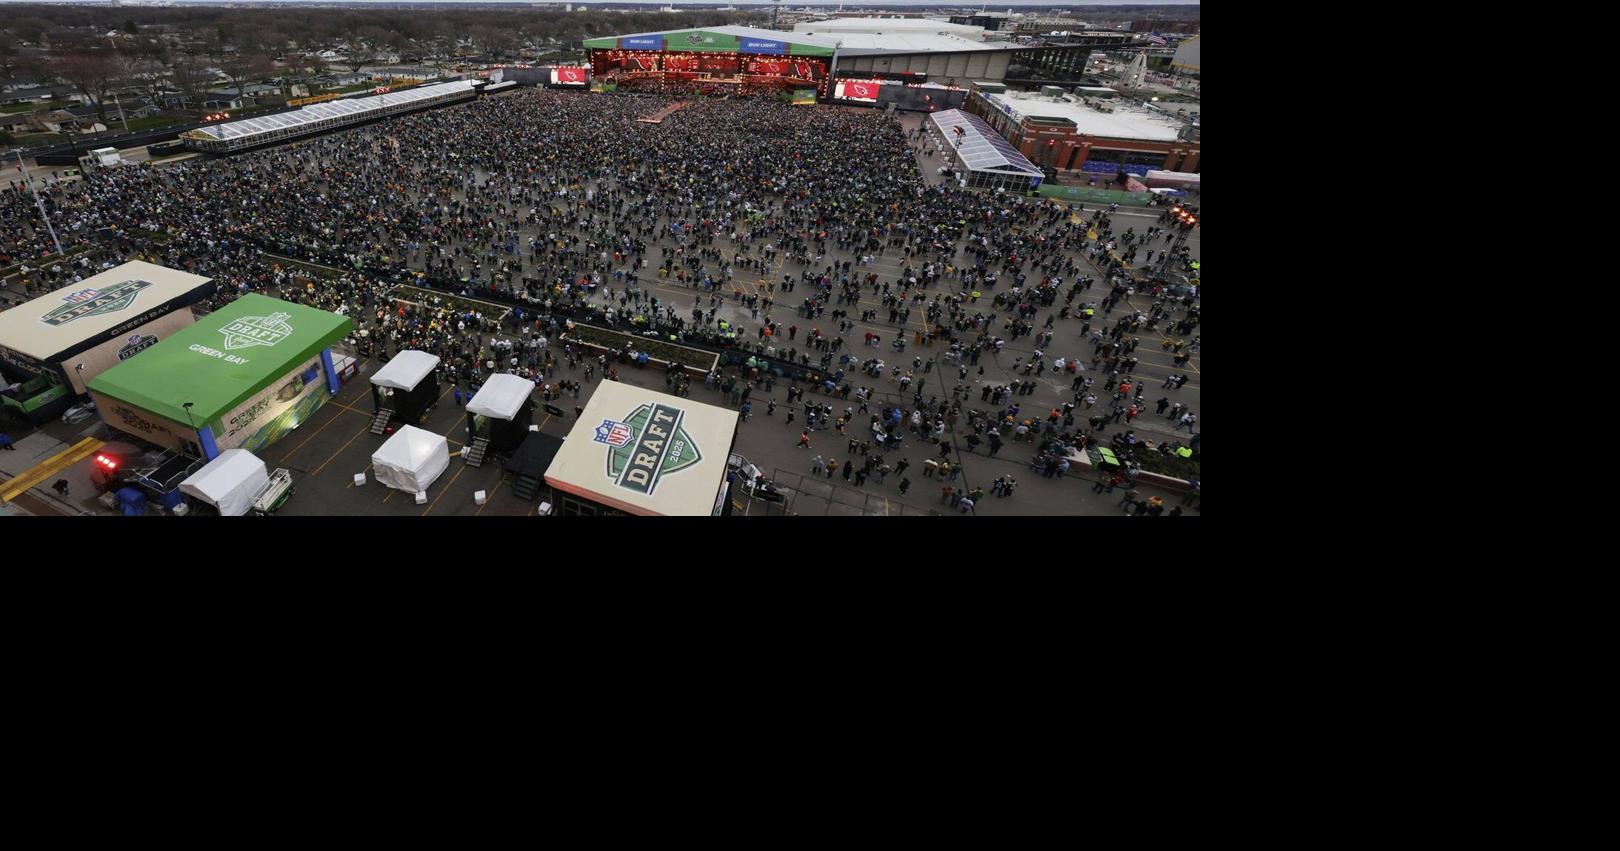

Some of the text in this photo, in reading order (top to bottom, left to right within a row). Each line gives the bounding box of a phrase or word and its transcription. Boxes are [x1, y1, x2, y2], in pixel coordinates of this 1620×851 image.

[55, 283, 140, 321] DRAFT
[71, 290, 97, 303] NFL
[111, 304, 169, 336] GREEN BAY
[229, 323, 281, 341] DRAFT
[188, 344, 250, 365] GREEN BAY
[607, 425, 629, 445] NFL
[627, 409, 674, 486] DRAFT
[670, 440, 685, 463] 2025
